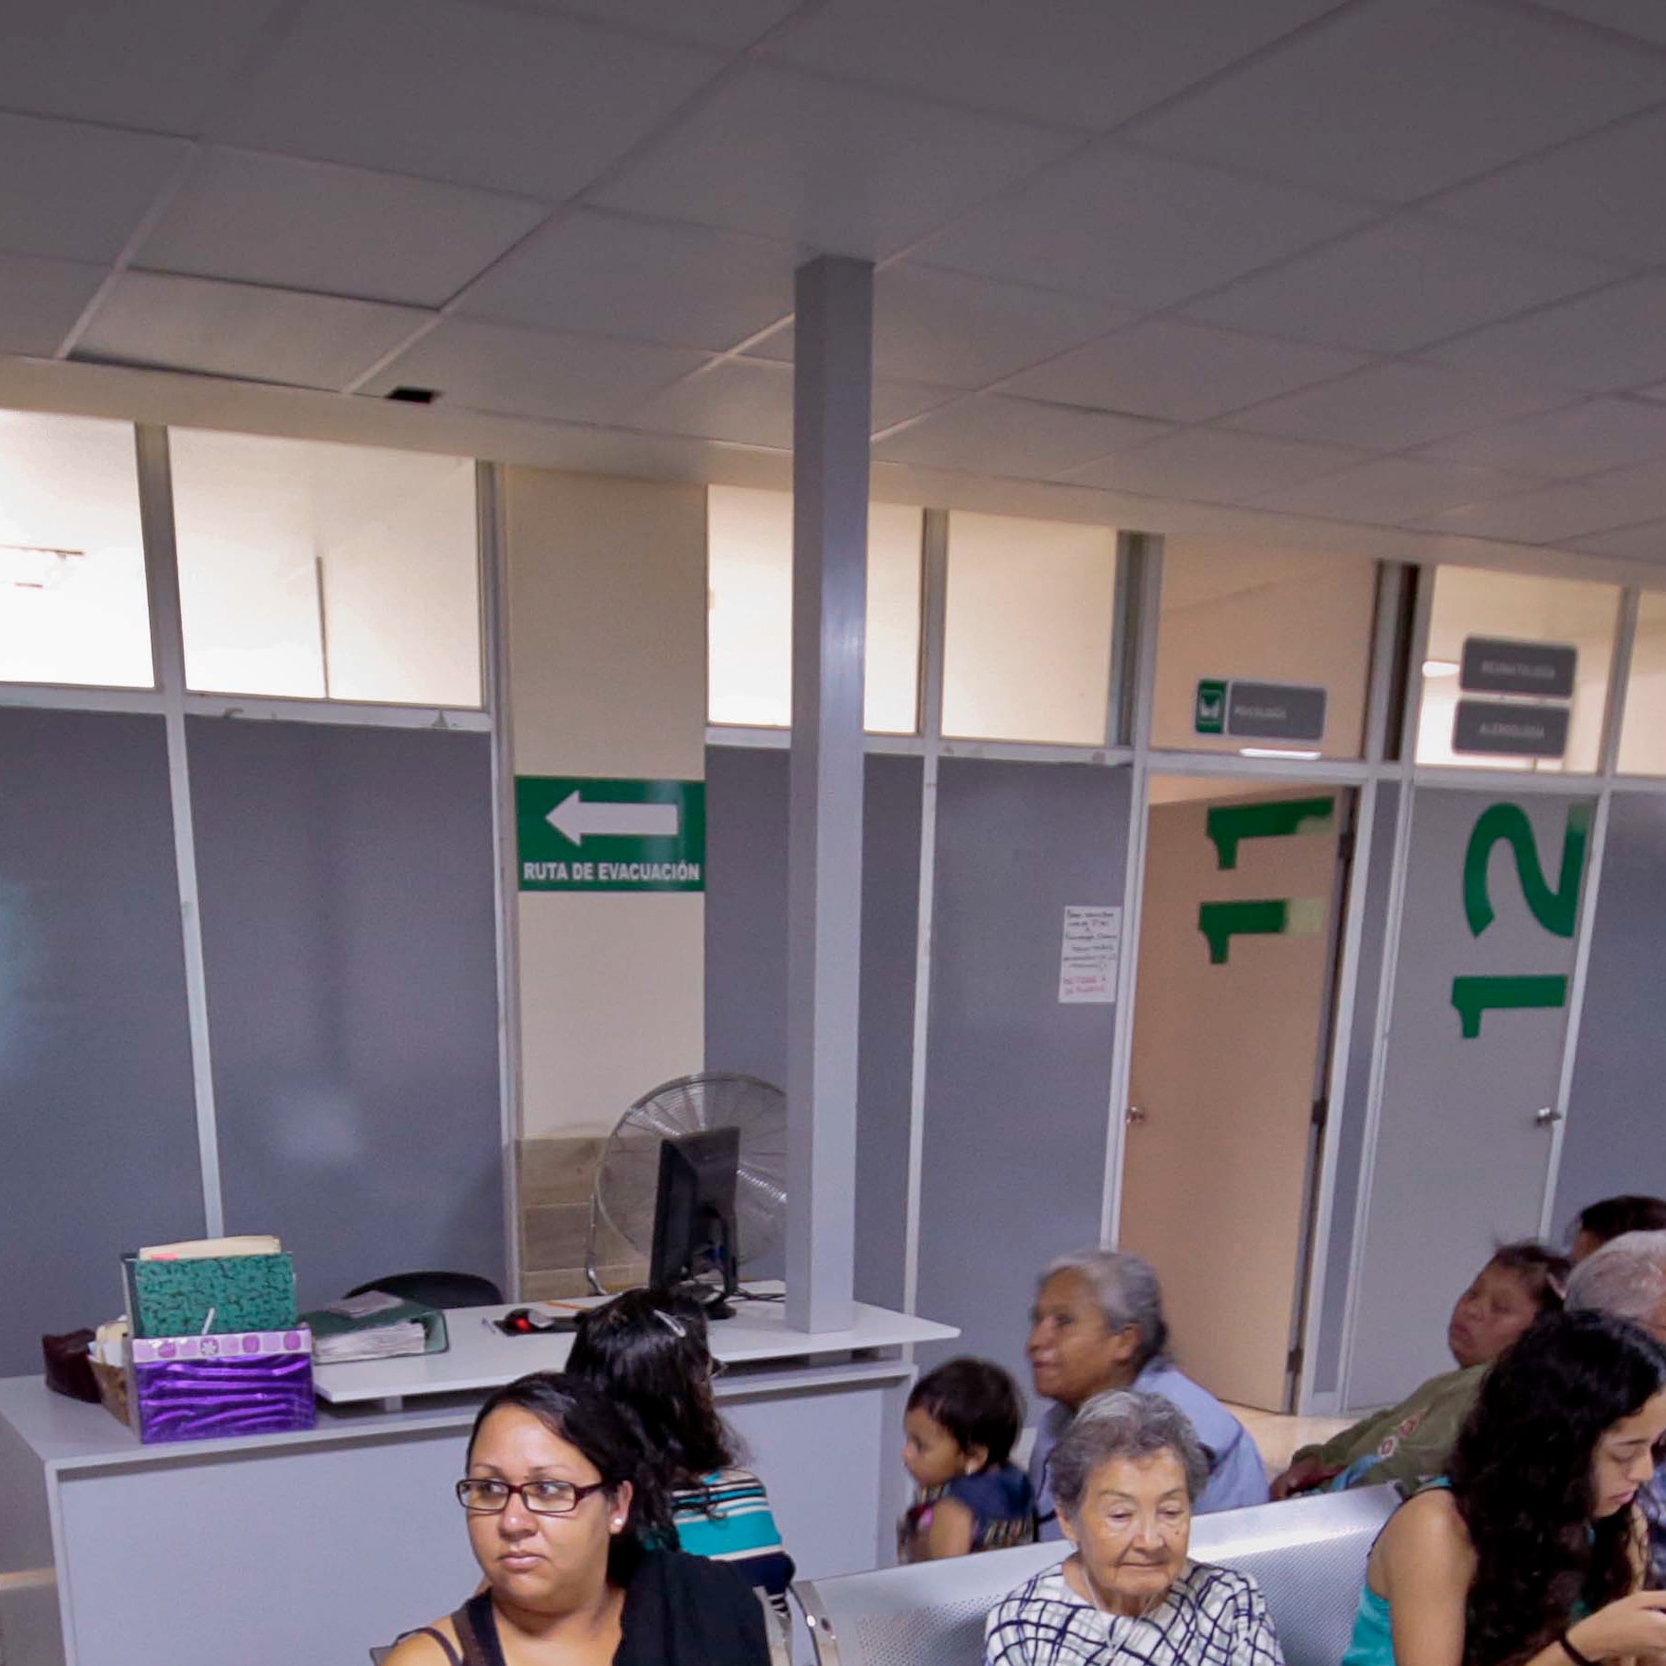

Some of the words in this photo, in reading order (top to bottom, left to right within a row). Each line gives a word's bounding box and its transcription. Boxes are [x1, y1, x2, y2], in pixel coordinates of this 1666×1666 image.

[523, 862, 569, 881] RUTA
[572, 862, 594, 881] DE
[597, 860, 701, 881] EVACUACIÓN
[1197, 797, 1333, 964] 11
[1450, 802, 1588, 1039] 12
